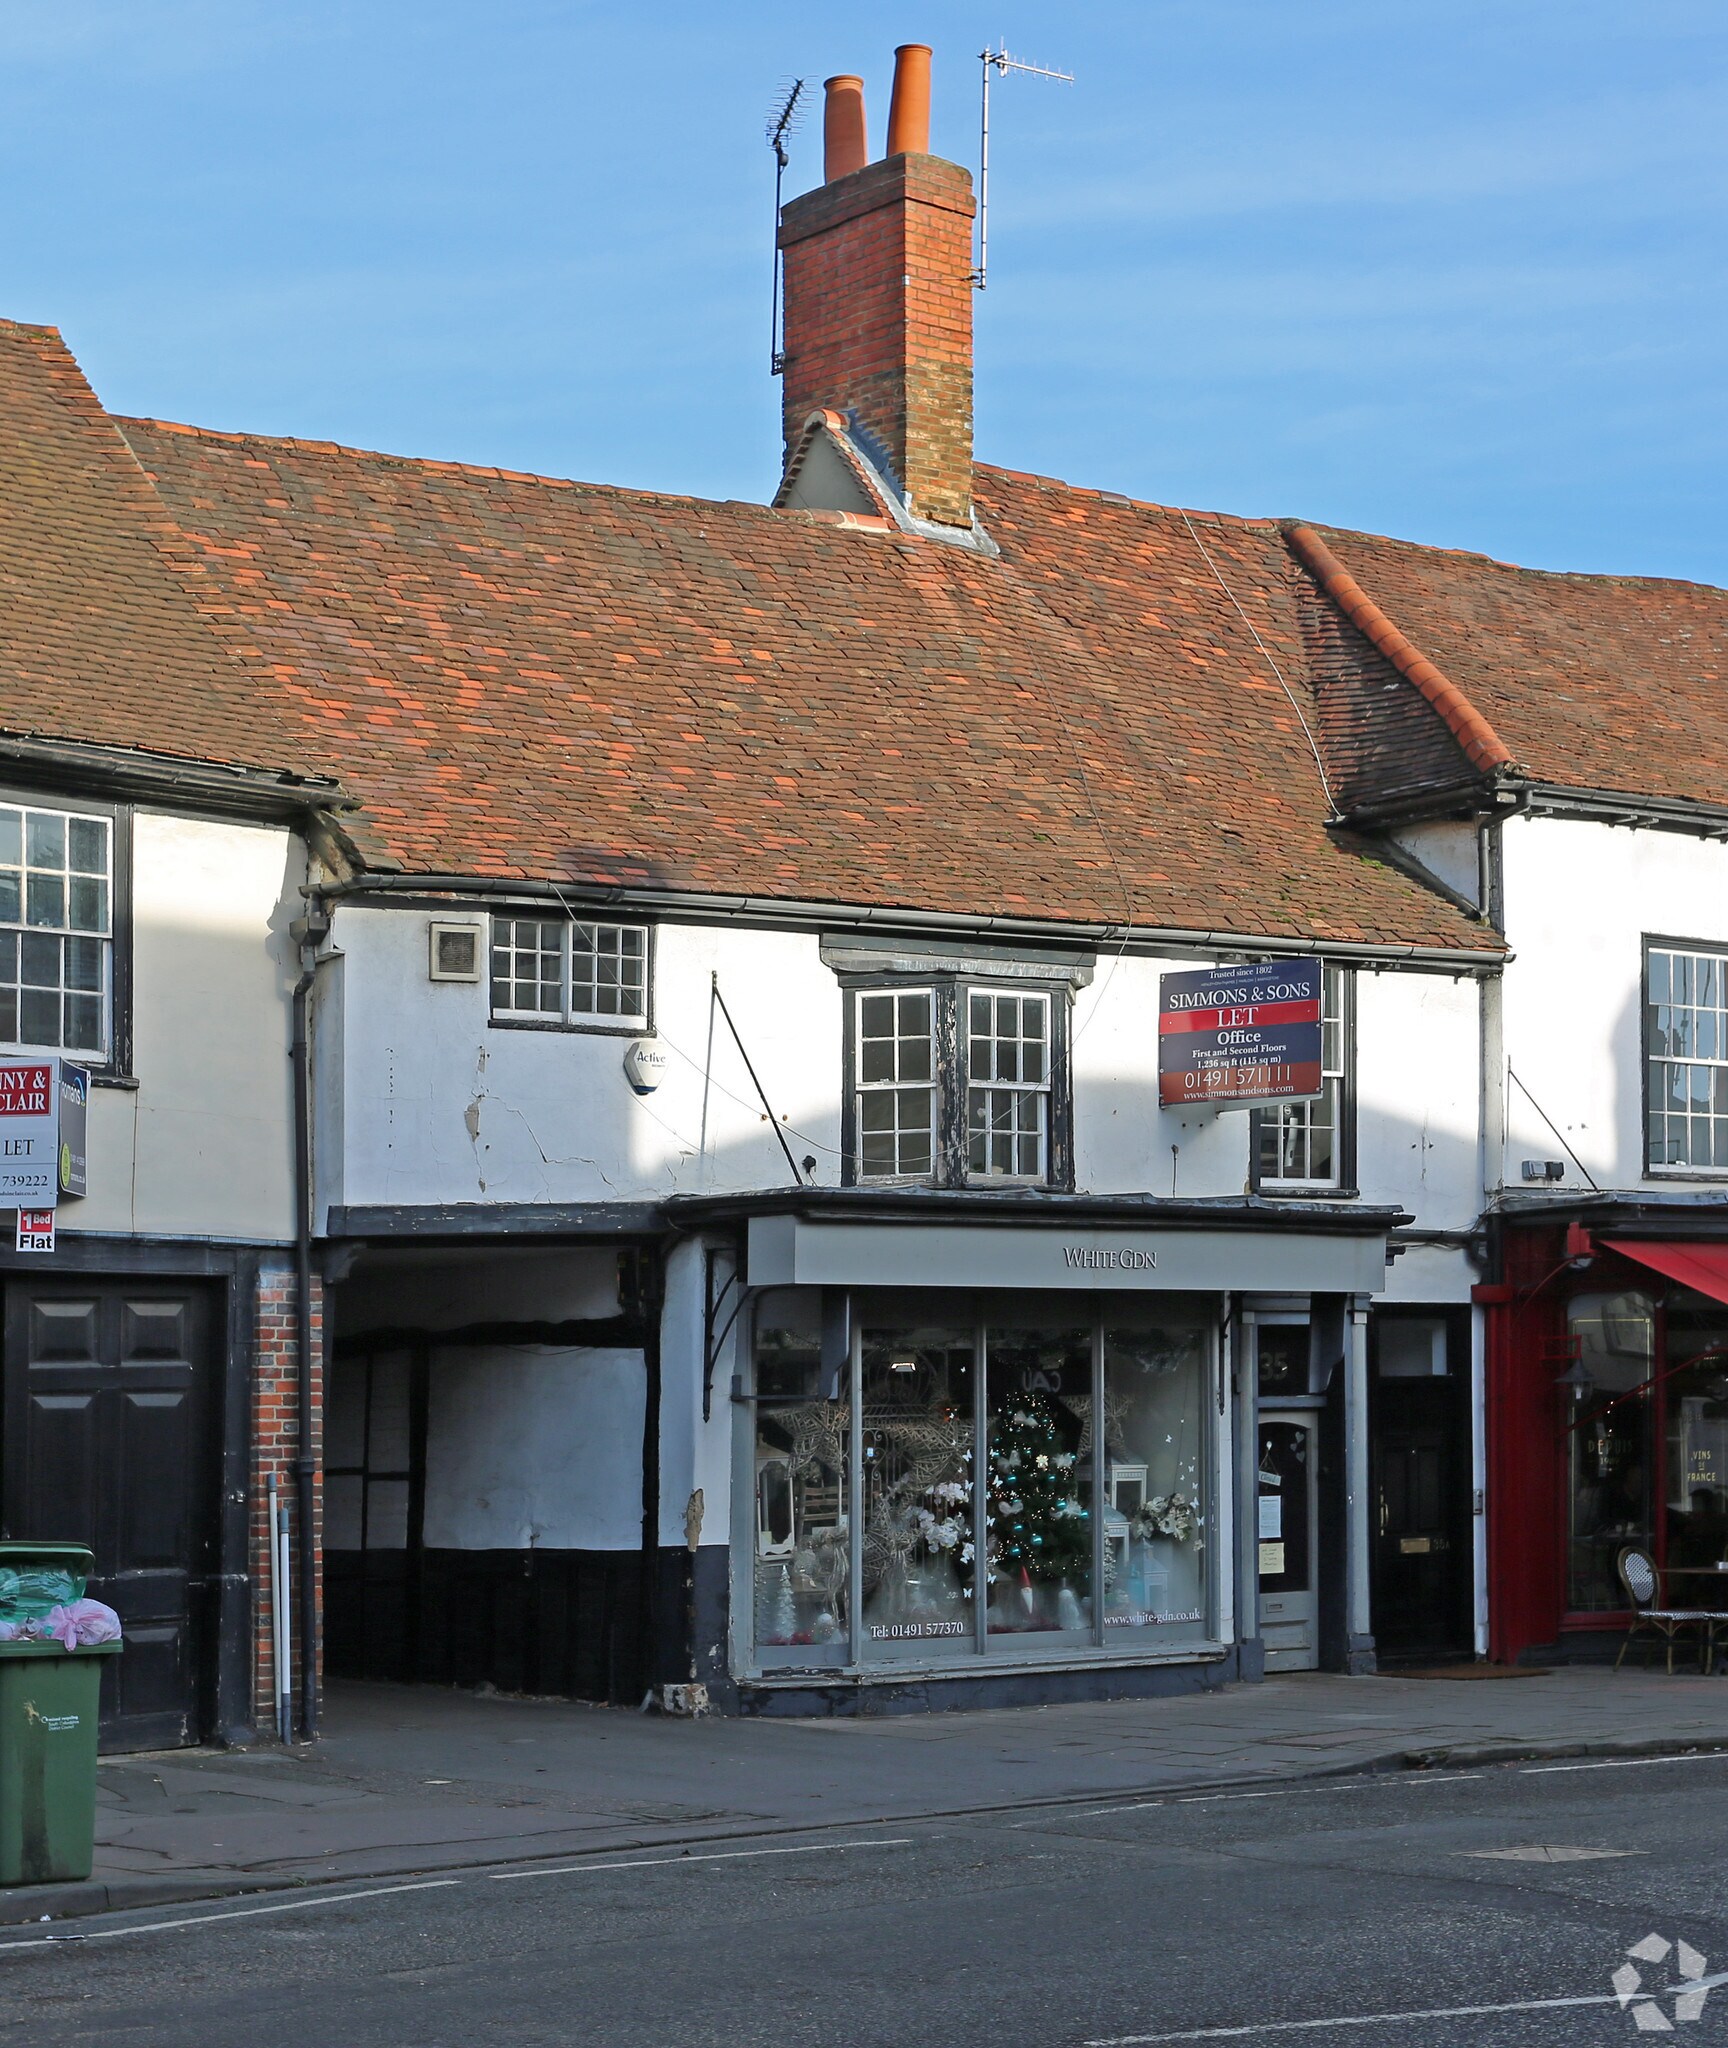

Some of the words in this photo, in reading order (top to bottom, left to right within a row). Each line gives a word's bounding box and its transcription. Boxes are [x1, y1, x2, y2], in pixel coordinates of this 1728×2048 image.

[1209, 969, 1235, 979] Trusted
[1236, 968, 1253, 977] since
[1256, 966, 1273, 975] 1802
[1169, 987, 1247, 1009] SIMMONS
[1251, 986, 1264, 1002] &
[1266, 982, 1310, 1000] SONS
[1217, 1007, 1259, 1028] LET
[1217, 1030, 1261, 1045] Office
[636, 1050, 666, 1064] Active
[1192, 1049, 1211, 1058] First
[1212, 1048, 1228, 1056] and
[1229, 1045, 1259, 1056] Second
[1261, 1043, 1287, 1053] Floors
[1197, 1059, 1219, 1069] 1,236
[1220, 1060, 1230, 1069] sq
[1231, 1058, 1238, 1067] ft
[1239, 1057, 1256, 1066] (115
[1259, 1057, 1268, 1065] sq
[1270, 1055, 1281, 1064] m)
[32, 1070, 47, 1089] &
[1184, 1069, 1229, 1089] 01491
[1236, 1065, 1291, 1085] 571111
[1183, 1084, 1294, 1100] www.simmonsandsons.com
[4, 1139, 35, 1156] LET
[2, 1175, 48, 1187] 739222
[23, 1213, 32, 1230] 1
[33, 1213, 51, 1224] Bed
[19, 1234, 52, 1249] Flat
[1064, 1247, 1117, 1268] WHITE
[1119, 1248, 1157, 1269] GDN
[1259, 1351, 1288, 1381] 35
[1587, 1439, 1632, 1456] DEPUIS
[1692, 1450, 1711, 1460] VINS
[1687, 1472, 1716, 1482] FRANCE
[1103, 1608, 1201, 1625] www.white-gdn.co.uk
[870, 1624, 889, 1638] Tel:
[891, 1623, 923, 1637] 01491
[925, 1621, 964, 1635] 577370
